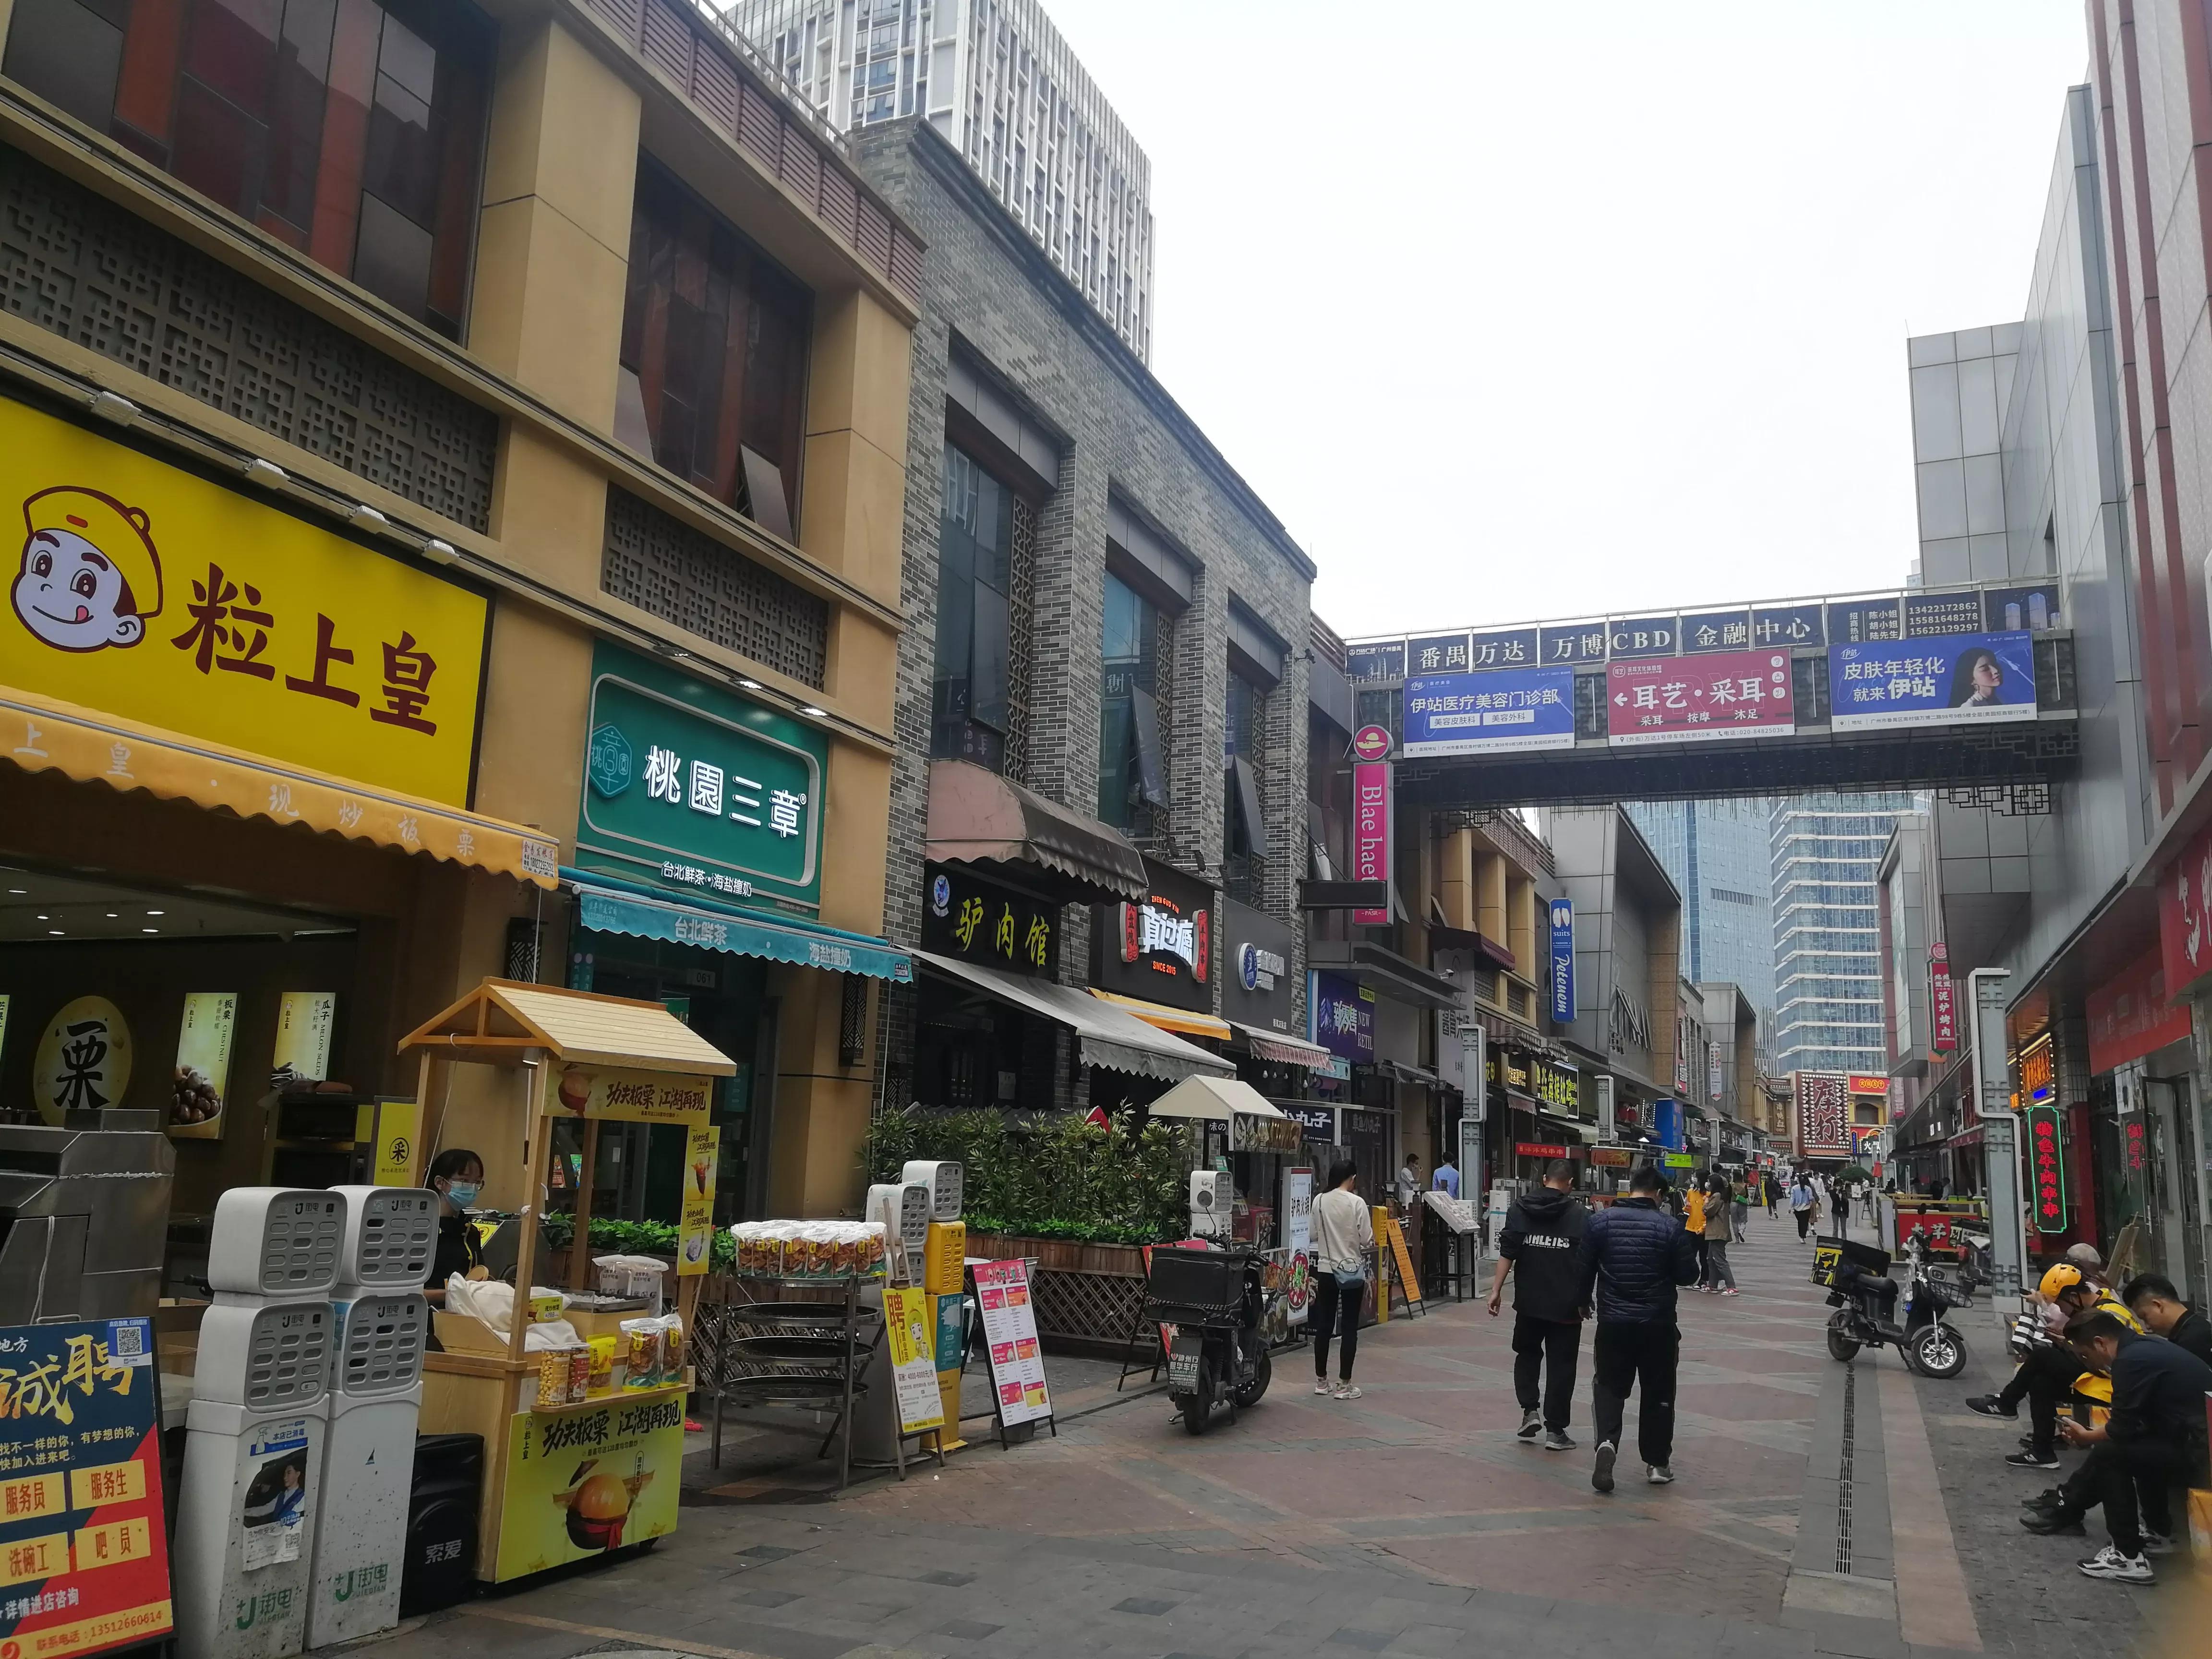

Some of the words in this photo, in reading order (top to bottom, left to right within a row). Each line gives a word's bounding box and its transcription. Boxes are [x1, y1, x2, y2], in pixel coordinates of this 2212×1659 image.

[1869, 609, 1898, 620] 陈小姐
[1909, 602, 1978, 615] 13422172862
[1909, 613, 1978, 625] 15581648278
[1695, 617, 1811, 647] 金融中心
[1849, 612, 1859, 642] 招商热线
[1869, 620, 1899, 630] 胡小姐
[1870, 630, 1899, 640] 陆先生
[1910, 623, 1979, 636] 15622129297
[171, 561, 438, 737] 粒上皇
[1627, 664, 1662, 673] 耳文化体验馆
[1844, 656, 1945, 680] 皮肤年轻化
[1410, 688, 1559, 714] 伊站医疗美容门诊部
[1853, 686, 1886, 702] 就来
[1887, 676, 1936, 700] 伊站
[1434, 716, 1475, 727] 美容皮肤科
[1491, 712, 1526, 722] 美容外科
[1640, 715, 1664, 726] 采耳
[1687, 711, 1711, 723] 按摩
[1734, 709, 1758, 720] 沐足
[642, 745, 800, 838] 桃園三章
[268, 784, 475, 856] 现炒板栗
[1361, 784, 1383, 831] Blae
[1151, 896, 1162, 904] ZHEN
[1163, 899, 1171, 909] GUO
[956, 896, 1050, 968] 驴肉馆
[1142, 904, 1193, 966] 真过瘾
[809, 942, 852, 968] 海盐撞奶
[696, 973, 711, 983] 061
[1153, 962, 1166, 973] SINCE
[1166, 965, 1176, 975] 2015
[222, 999, 233, 1021] 板栗
[320, 999, 331, 1021] 瓜子
[1358, 1011, 1370, 1027] NEW
[1938, 992, 1951, 1037] 泥炉烤肉
[218, 1025, 228, 1062] CHESTNUT
[318, 1024, 326, 1051] MELON
[1358, 1033, 1373, 1050] RETIL
[54, 1019, 111, 1109] 栗
[606, 1081, 656, 1110] 功夫板栗
[659, 1086, 706, 1111] 江湖再现
[1813, 1080, 1838, 1143] 摩打
[391, 1142, 406, 1162] 采
[2035, 1121, 2060, 1218] 特色牛肉串串
[1522, 1234, 1570, 1248] ATHLETES
[886, 1292, 906, 1331] 聘
[273, 1428, 305, 1441] 本店已消毒
[542, 1409, 610, 1458] 功夫板栗
[617, 1399, 681, 1437] 江湖再现
[5, 1481, 46, 1515] 服务员
[90, 1468, 128, 1500] 服务生
[8, 1542, 49, 1578] 洗碗工
[425, 1539, 462, 1564] 索爱
[358, 1563, 388, 1588] 街电
[5, 1586, 80, 1621] 详情进店咨询
[259, 1588, 292, 1614] 街电
[90, 1610, 162, 1638] 13512660614
